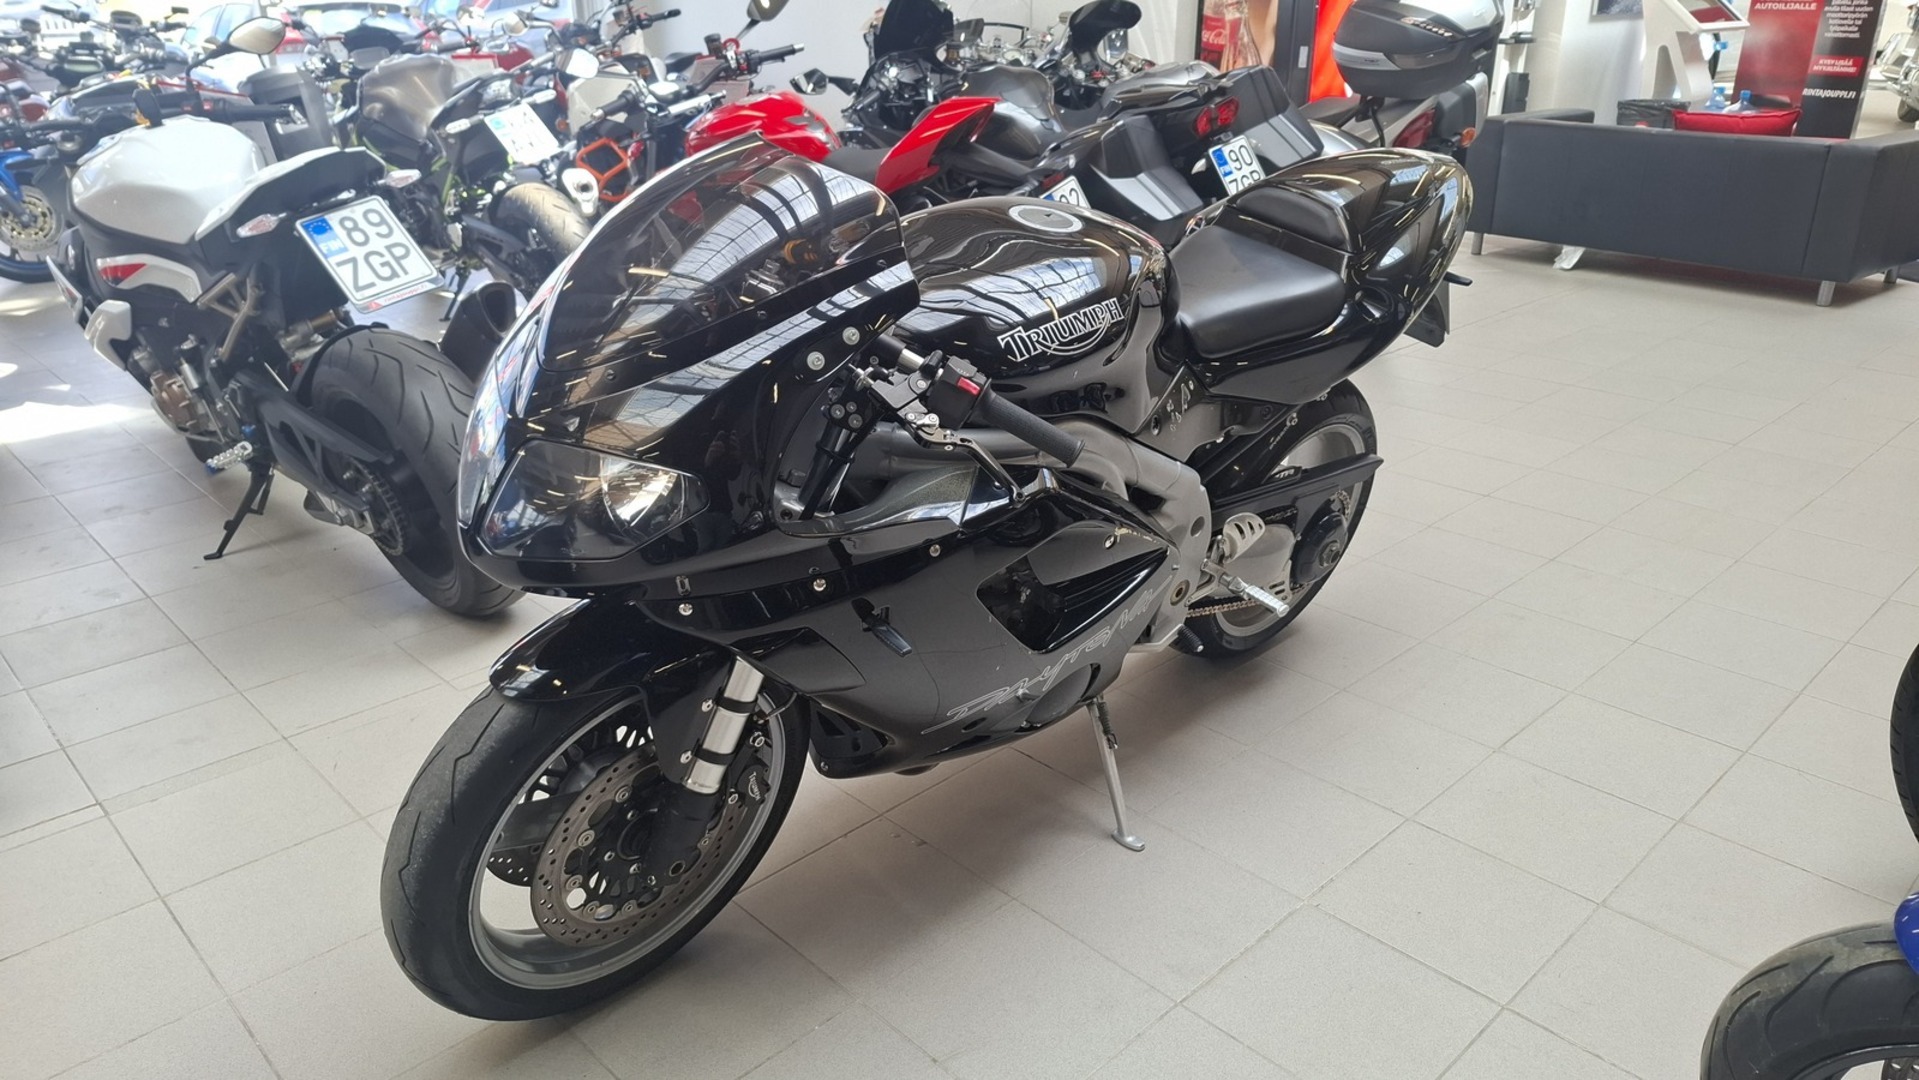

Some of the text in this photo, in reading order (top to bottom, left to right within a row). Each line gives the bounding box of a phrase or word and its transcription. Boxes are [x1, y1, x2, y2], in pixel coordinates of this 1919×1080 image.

[1228, 144, 1253, 171] 90
[338, 208, 394, 247] 89
[335, 242, 411, 293] ZGP
[997, 297, 1124, 362] TRIUMPH
